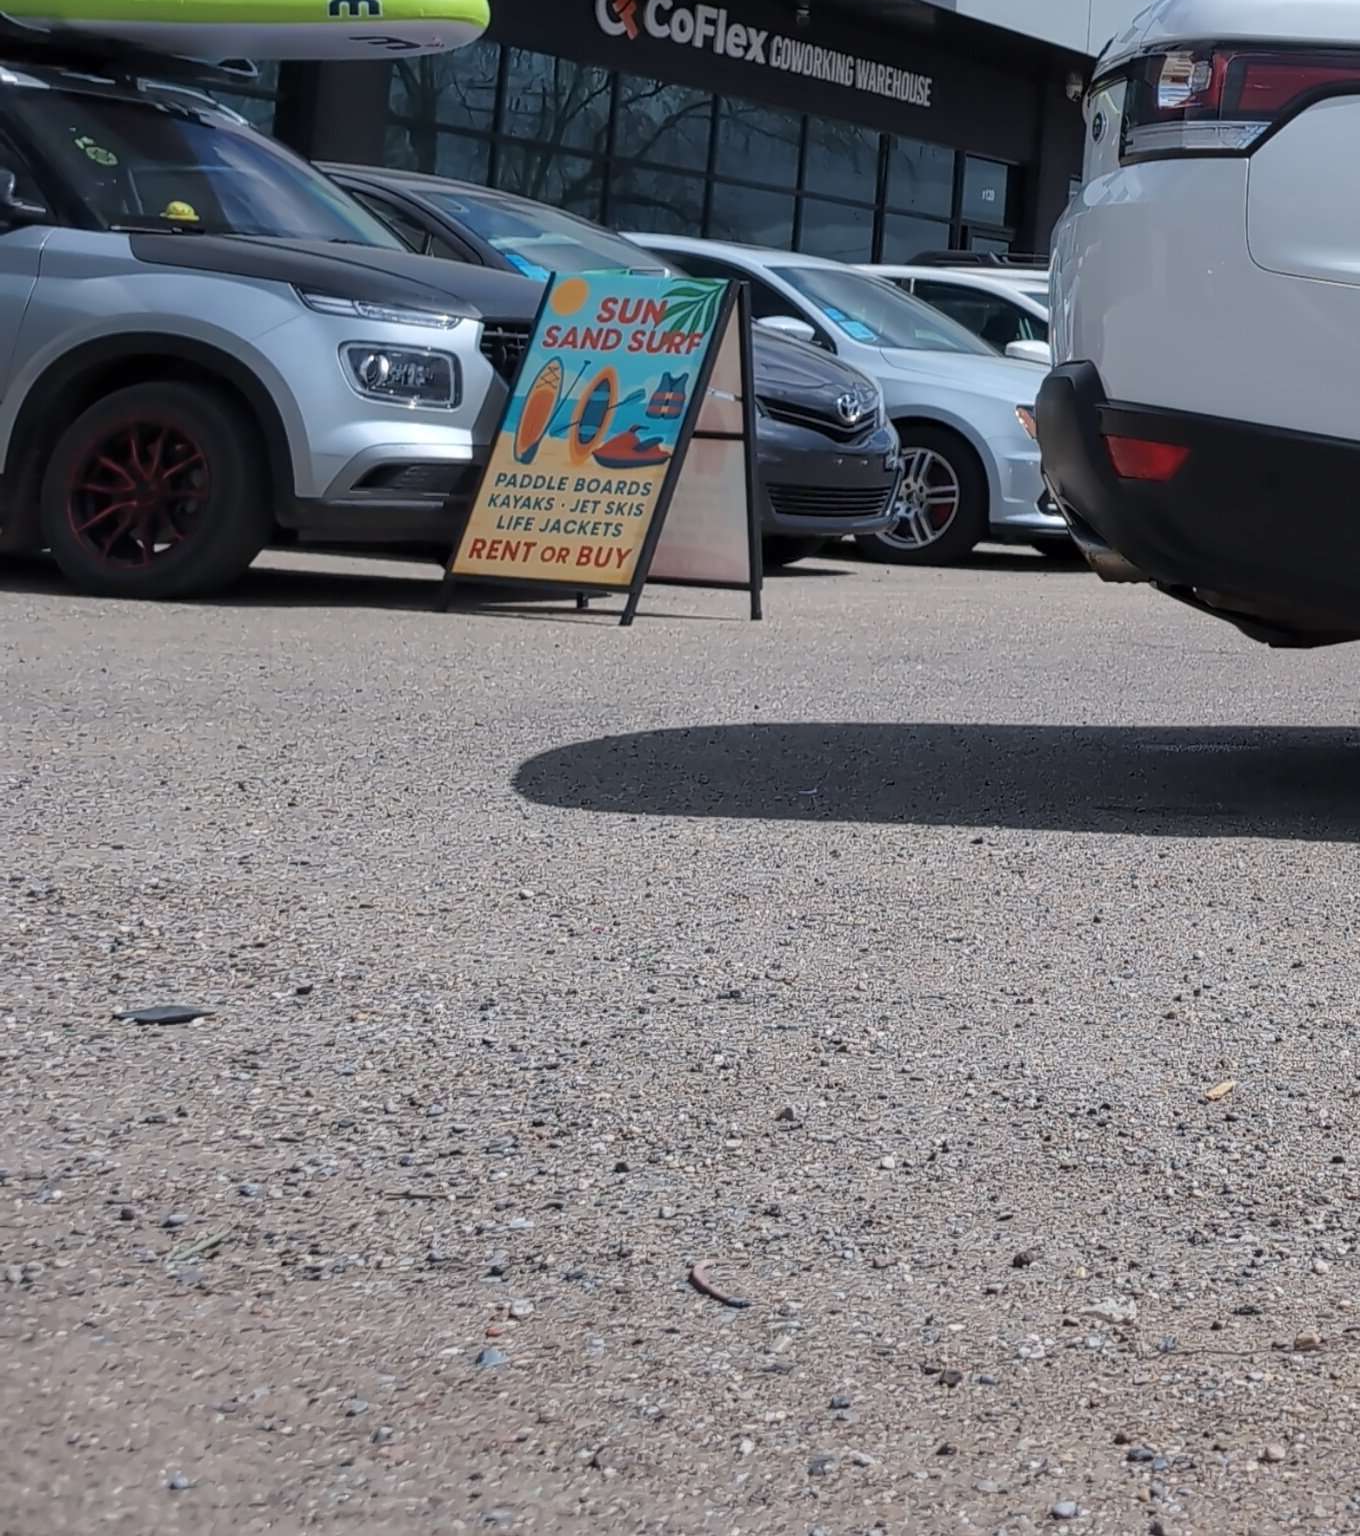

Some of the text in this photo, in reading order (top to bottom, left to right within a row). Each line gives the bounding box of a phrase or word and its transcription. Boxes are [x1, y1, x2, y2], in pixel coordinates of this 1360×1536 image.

[769, 34, 855, 87] COWORKING
[855, 58, 932, 107] WAREHOUSE
[596, 296, 668, 327] SUN
[542, 325, 704, 355] SAND SURF
[495, 472, 652, 497] PADDLE BOARDS
[487, 493, 645, 517] KAYAKS JET SKIS
[496, 515, 624, 538] LIFE JACKETS
[468, 538, 633, 569] RENT OR BUY
